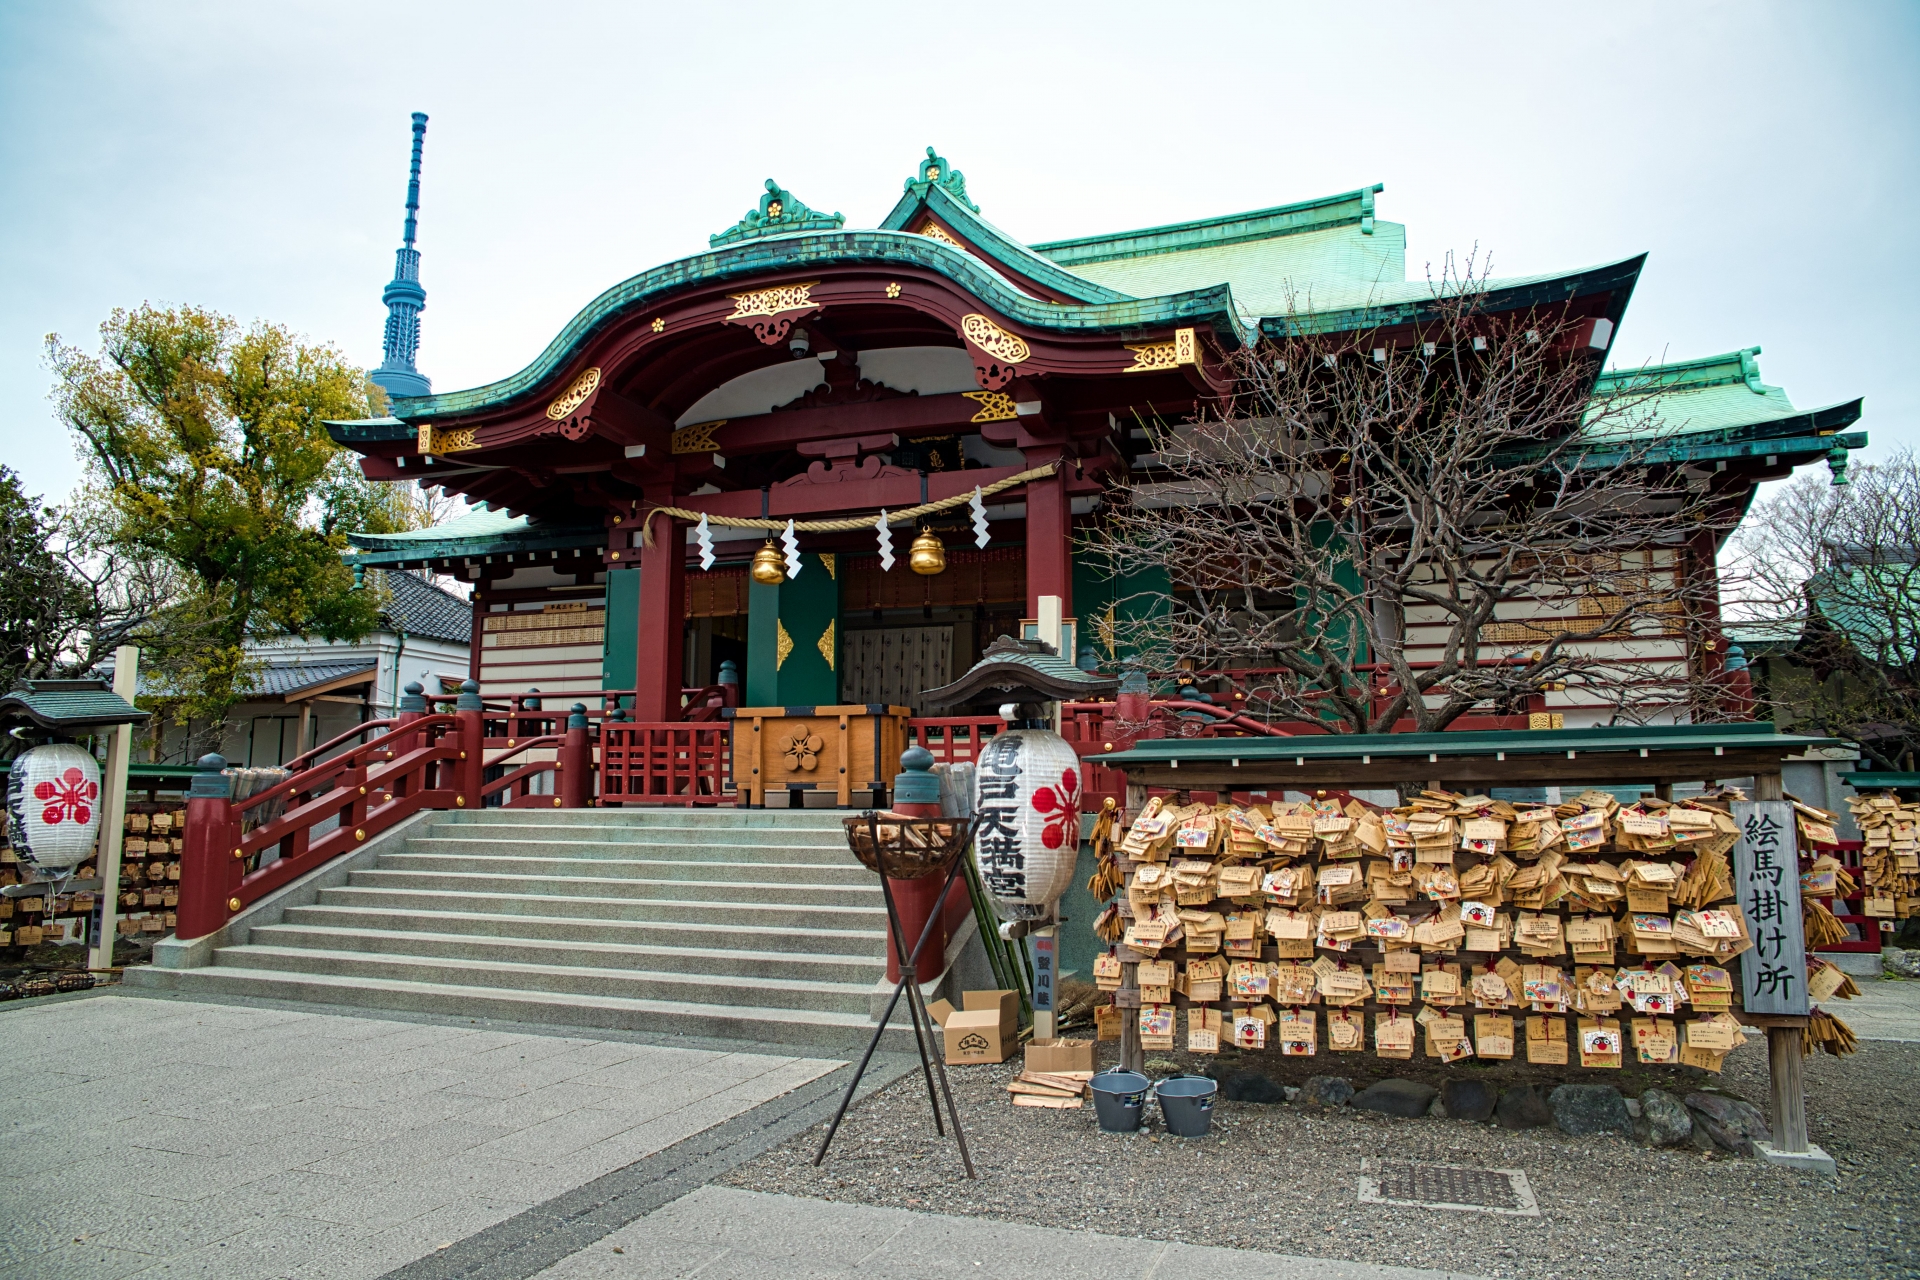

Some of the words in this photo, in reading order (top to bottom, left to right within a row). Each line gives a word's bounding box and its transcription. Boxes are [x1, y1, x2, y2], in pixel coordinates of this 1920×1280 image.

[1744, 813, 1795, 1000] 絵馬掛け所
